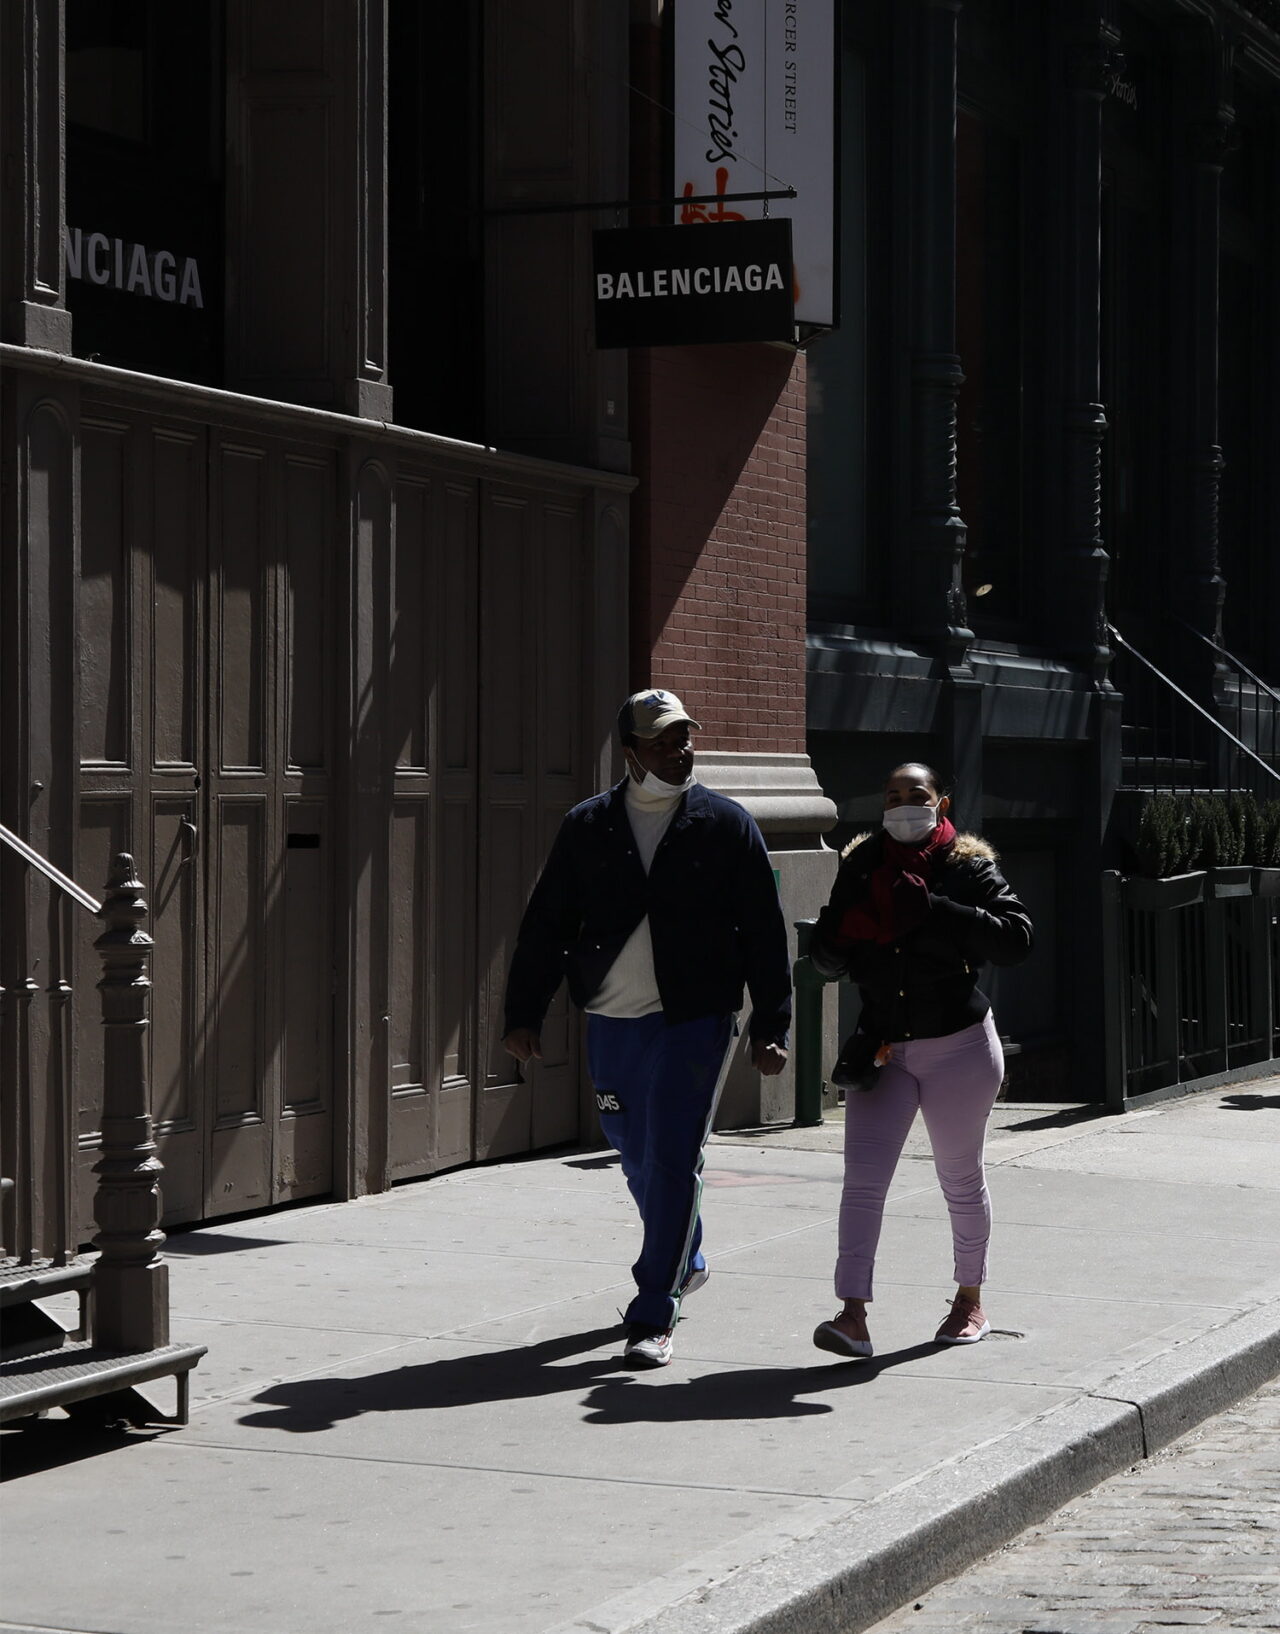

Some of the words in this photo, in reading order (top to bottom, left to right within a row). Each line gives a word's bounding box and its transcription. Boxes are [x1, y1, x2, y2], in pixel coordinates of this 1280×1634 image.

[784, 0, 798, 52] RCER
[706, 39, 745, 163] Stories
[784, 61, 798, 134] STREET
[596, 263, 784, 300] BALENCIAGA
